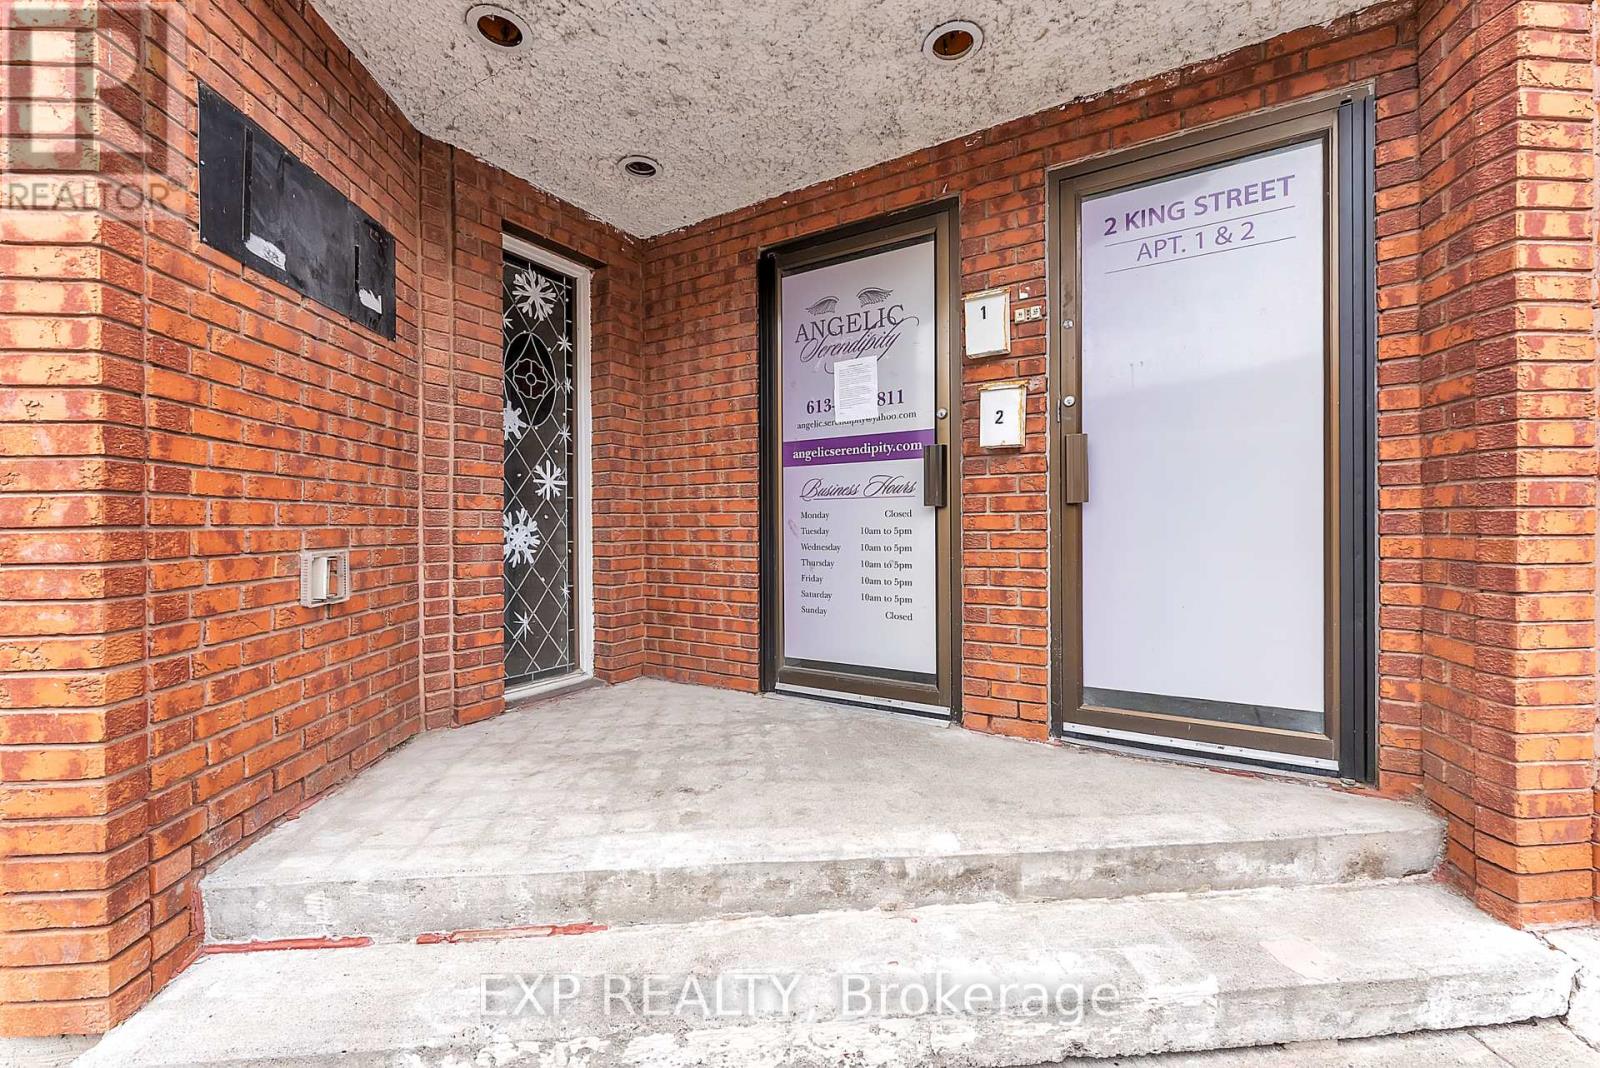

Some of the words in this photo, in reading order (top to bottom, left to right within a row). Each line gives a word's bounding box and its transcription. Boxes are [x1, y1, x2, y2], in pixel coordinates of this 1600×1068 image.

[1103, 217, 1118, 236] 2
[1124, 201, 1186, 231] KING
[1193, 174, 1296, 216] STREET
[1136, 235, 1186, 262] APT.
[1195, 231, 1203, 249] 1
[1214, 225, 1233, 245] &
[1240, 221, 1256, 241] 2
[980, 305, 987, 320] 1
[795, 304, 904, 343] ANGELIC
[800, 317, 919, 362] Serendipity
[994, 409, 1004, 425] 2
[792, 441, 923, 462] angelicserendipity.com
[801, 478, 861, 500] Business
[863, 475, 918, 498] Hours
[800, 511, 830, 521] Monday
[884, 509, 912, 518] Closed
[800, 527, 830, 537] Tuesday
[860, 527, 882, 536] 10am
[883, 527, 892, 535] to
[893, 527, 913, 538] 5pm
[800, 543, 841, 553] Wednesday
[860, 543, 882, 552] 10am
[883, 544, 892, 552] to
[893, 543, 913, 554] 5pm
[800, 559, 835, 569] Thursday
[860, 559, 882, 568] 10am
[883, 560, 892, 569] to
[894, 560, 913, 571] 5pm
[800, 574, 824, 584] Friday
[860, 576, 882, 585] 10am
[883, 577, 892, 586] to
[894, 577, 913, 588] 5pm
[800, 590, 833, 601] Saturday
[860, 593, 882, 602] 10am
[883, 594, 892, 603] to
[894, 594, 913, 606] 5pm
[800, 606, 827, 616] Sunday
[885, 611, 913, 621] Closed
